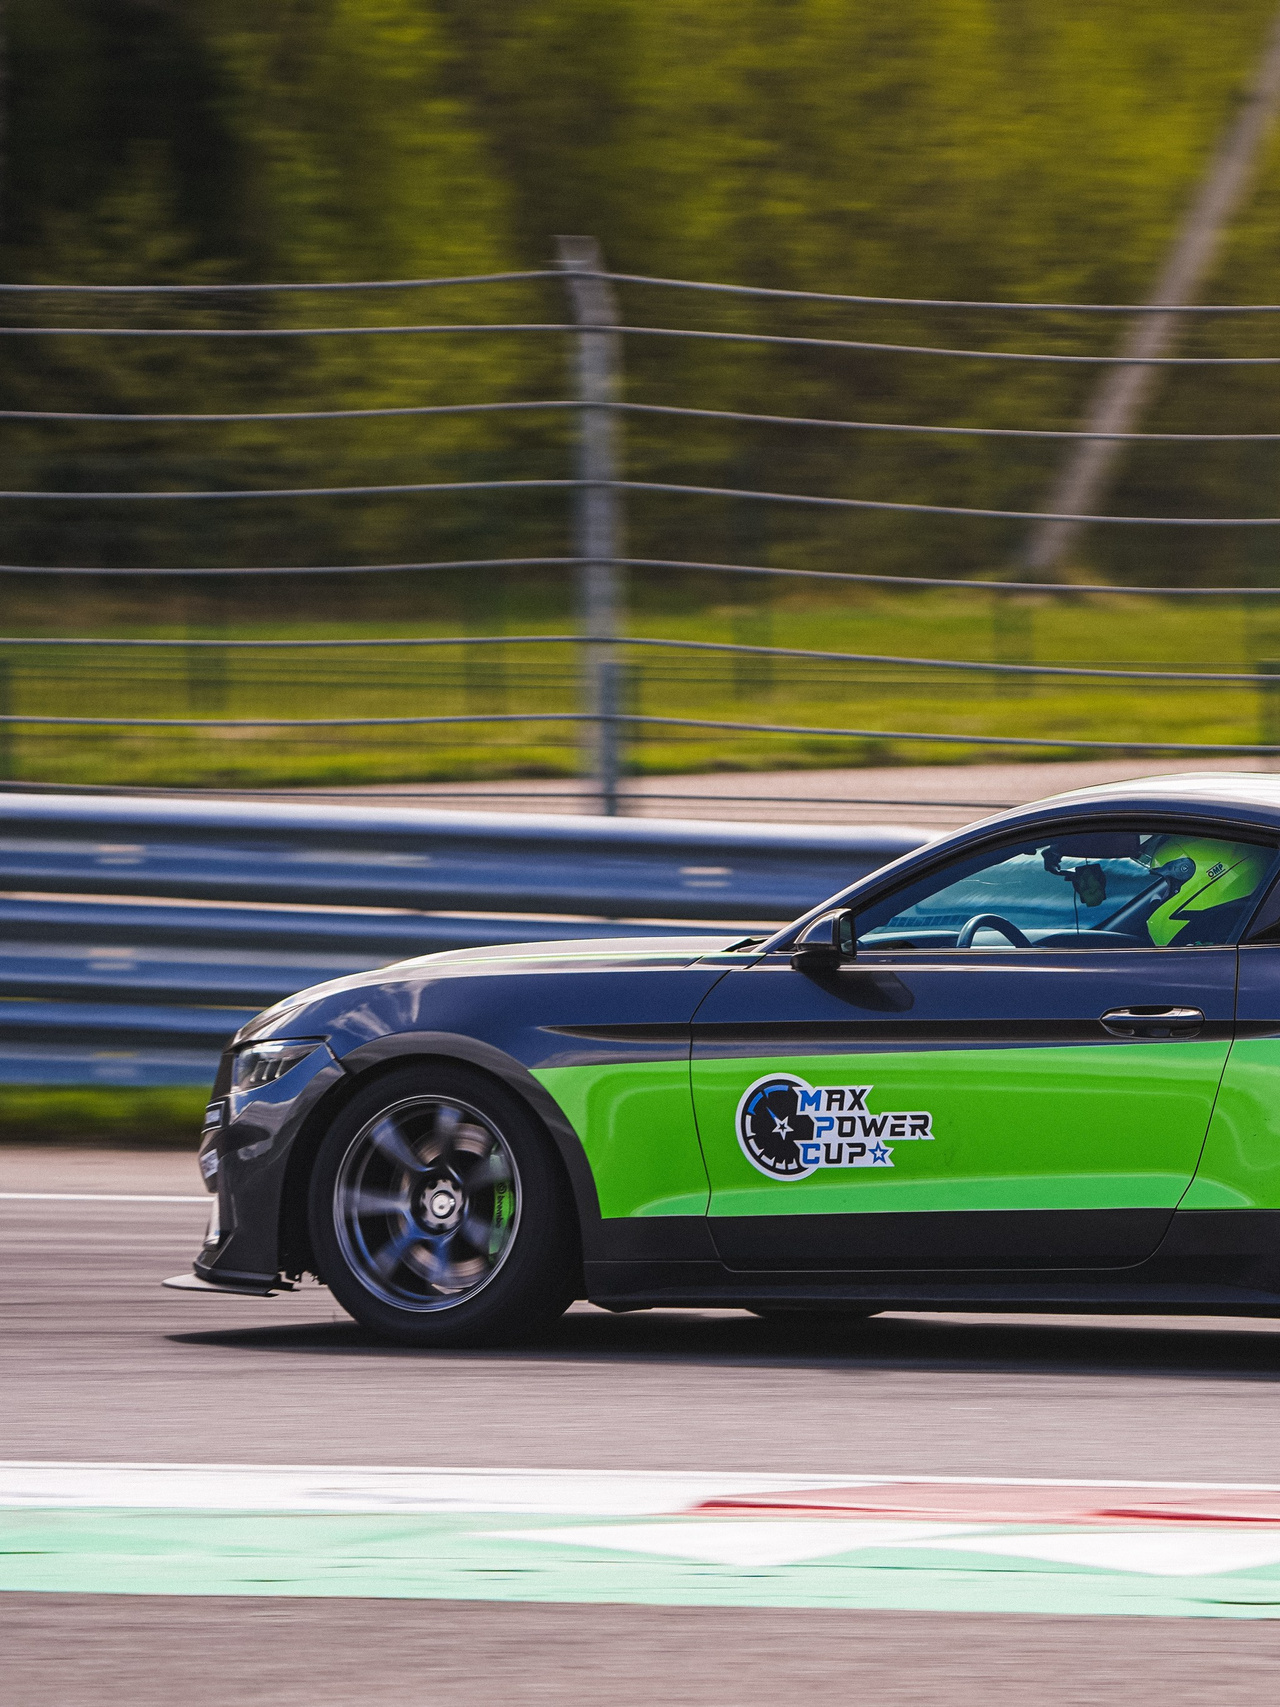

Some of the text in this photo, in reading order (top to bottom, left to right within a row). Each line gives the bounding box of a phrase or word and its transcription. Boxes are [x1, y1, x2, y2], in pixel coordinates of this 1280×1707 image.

[1207, 863, 1224, 878] OMP
[799, 1088, 868, 1112] MAX
[814, 1114, 930, 1139] POWER
[800, 1142, 867, 1165] CUP
